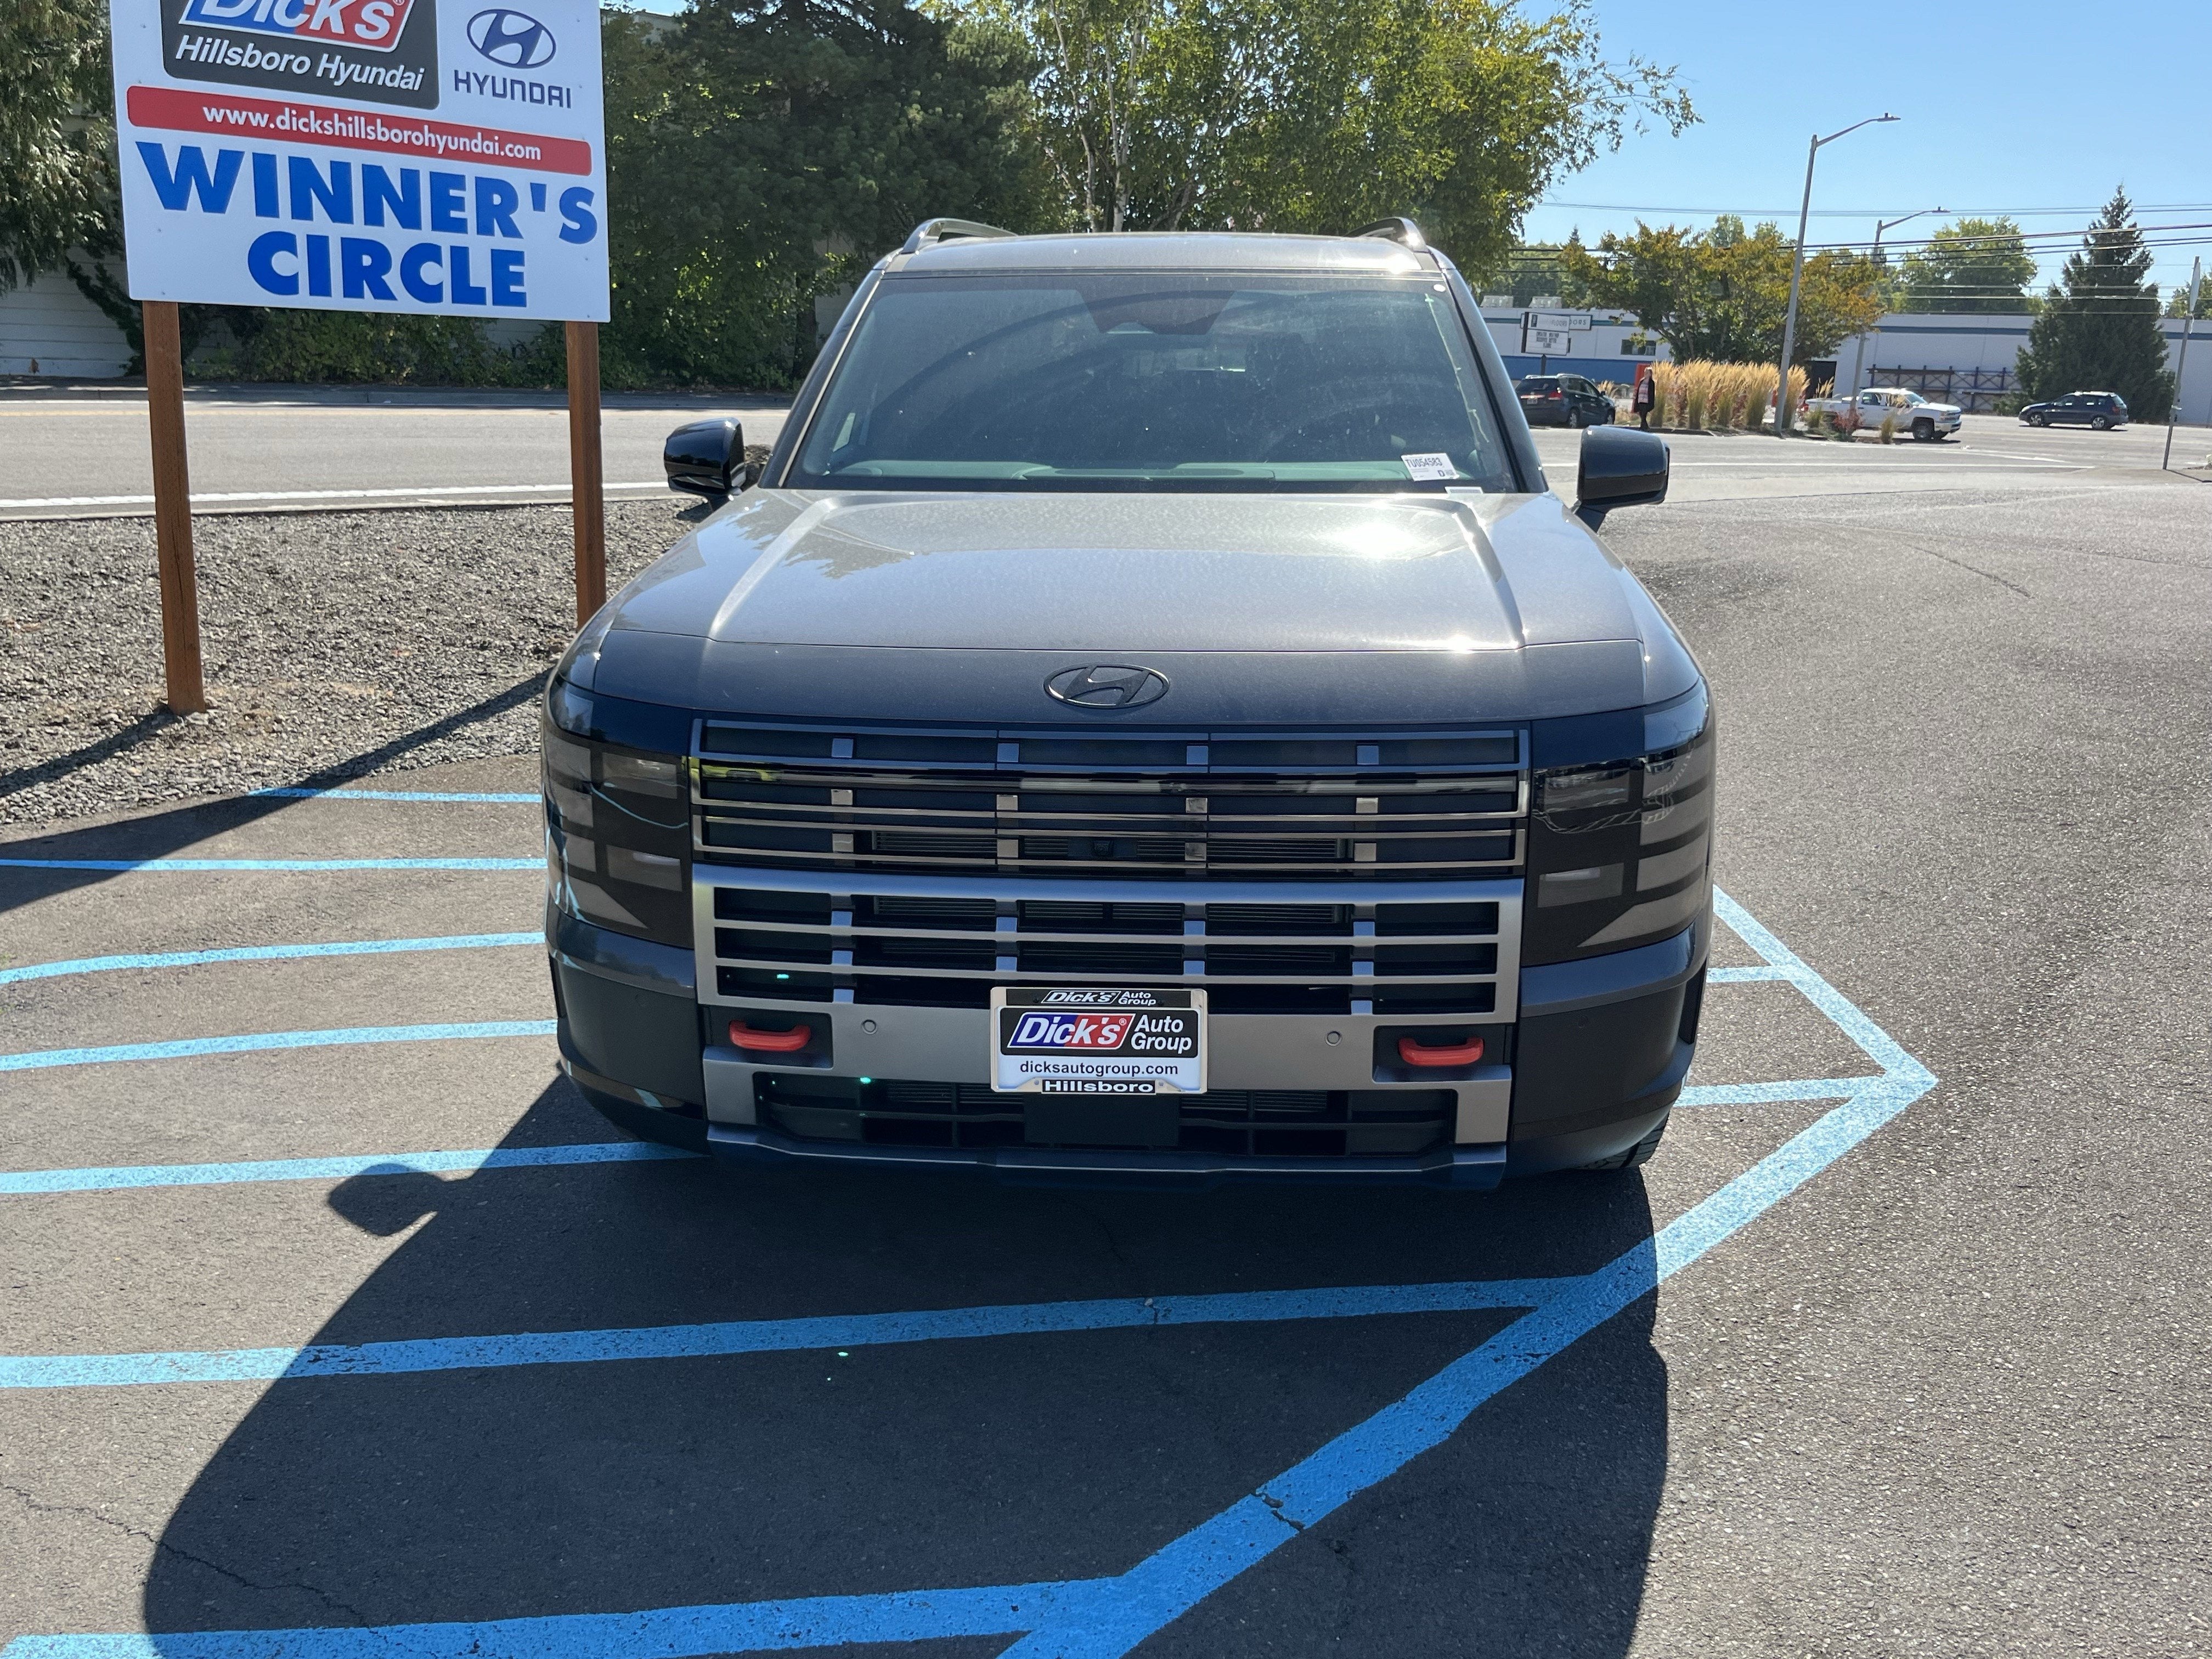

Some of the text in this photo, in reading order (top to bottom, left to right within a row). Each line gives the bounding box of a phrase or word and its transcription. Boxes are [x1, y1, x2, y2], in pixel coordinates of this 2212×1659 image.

[200, 0, 394, 40] icks
[176, 35, 425, 91] Hillsboro Hyundai
[454, 70, 571, 109] HYUNDAI
[203, 105, 541, 161] www.dickshillsborohyundai.com
[135, 141, 597, 245] WINNER'S
[247, 230, 527, 307] CIRCLE
[1046, 991, 1113, 1003] Dick's
[1118, 997, 1156, 1006] Group
[1017, 1016, 1121, 1045] Dick's
[1134, 1014, 1184, 1033] Auto
[1131, 1032, 1192, 1054] Group
[1020, 1060, 1178, 1077] dicksautogroup.com
[1045, 1080, 1154, 1093] Hillsboro
